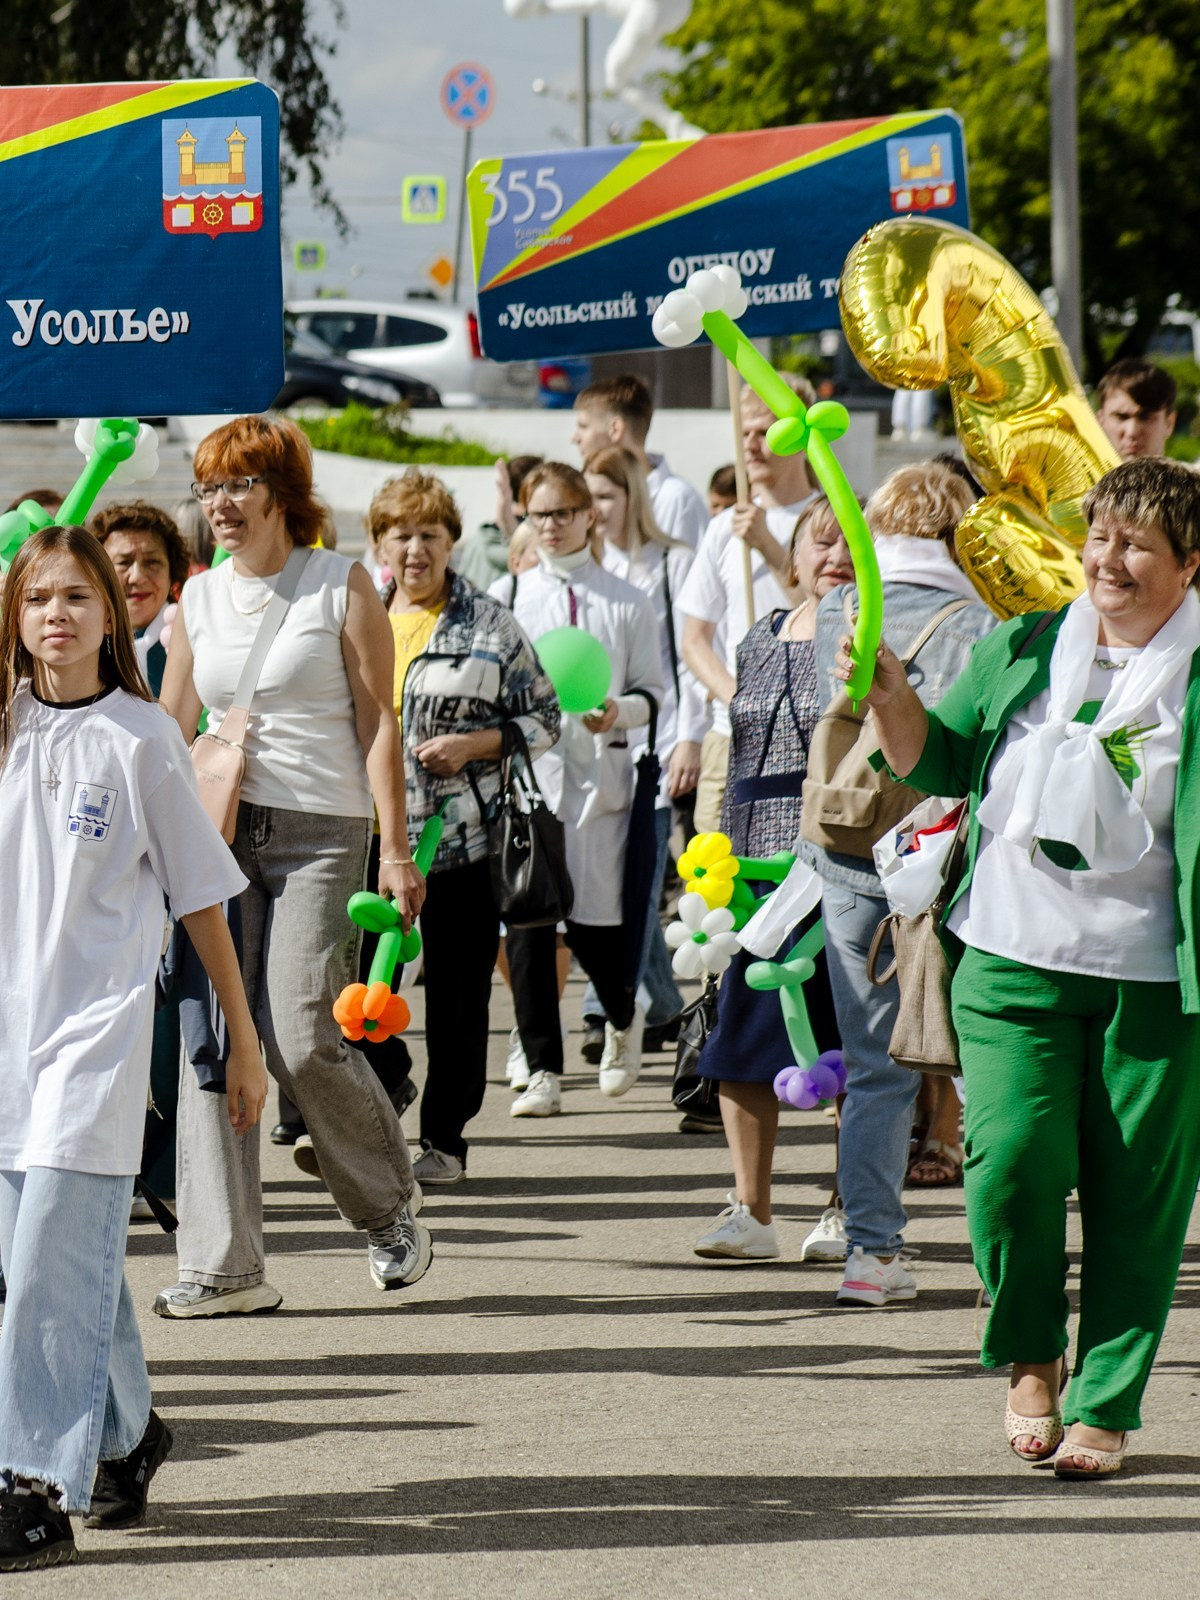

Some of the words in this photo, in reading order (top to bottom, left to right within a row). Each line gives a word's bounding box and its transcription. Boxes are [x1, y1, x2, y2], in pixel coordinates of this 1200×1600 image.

[479, 166, 564, 228] 355
[5, 298, 191, 348] Усолье»
[498, 290, 638, 330] «Усольский
[24, 1524, 47, 1543] ST
